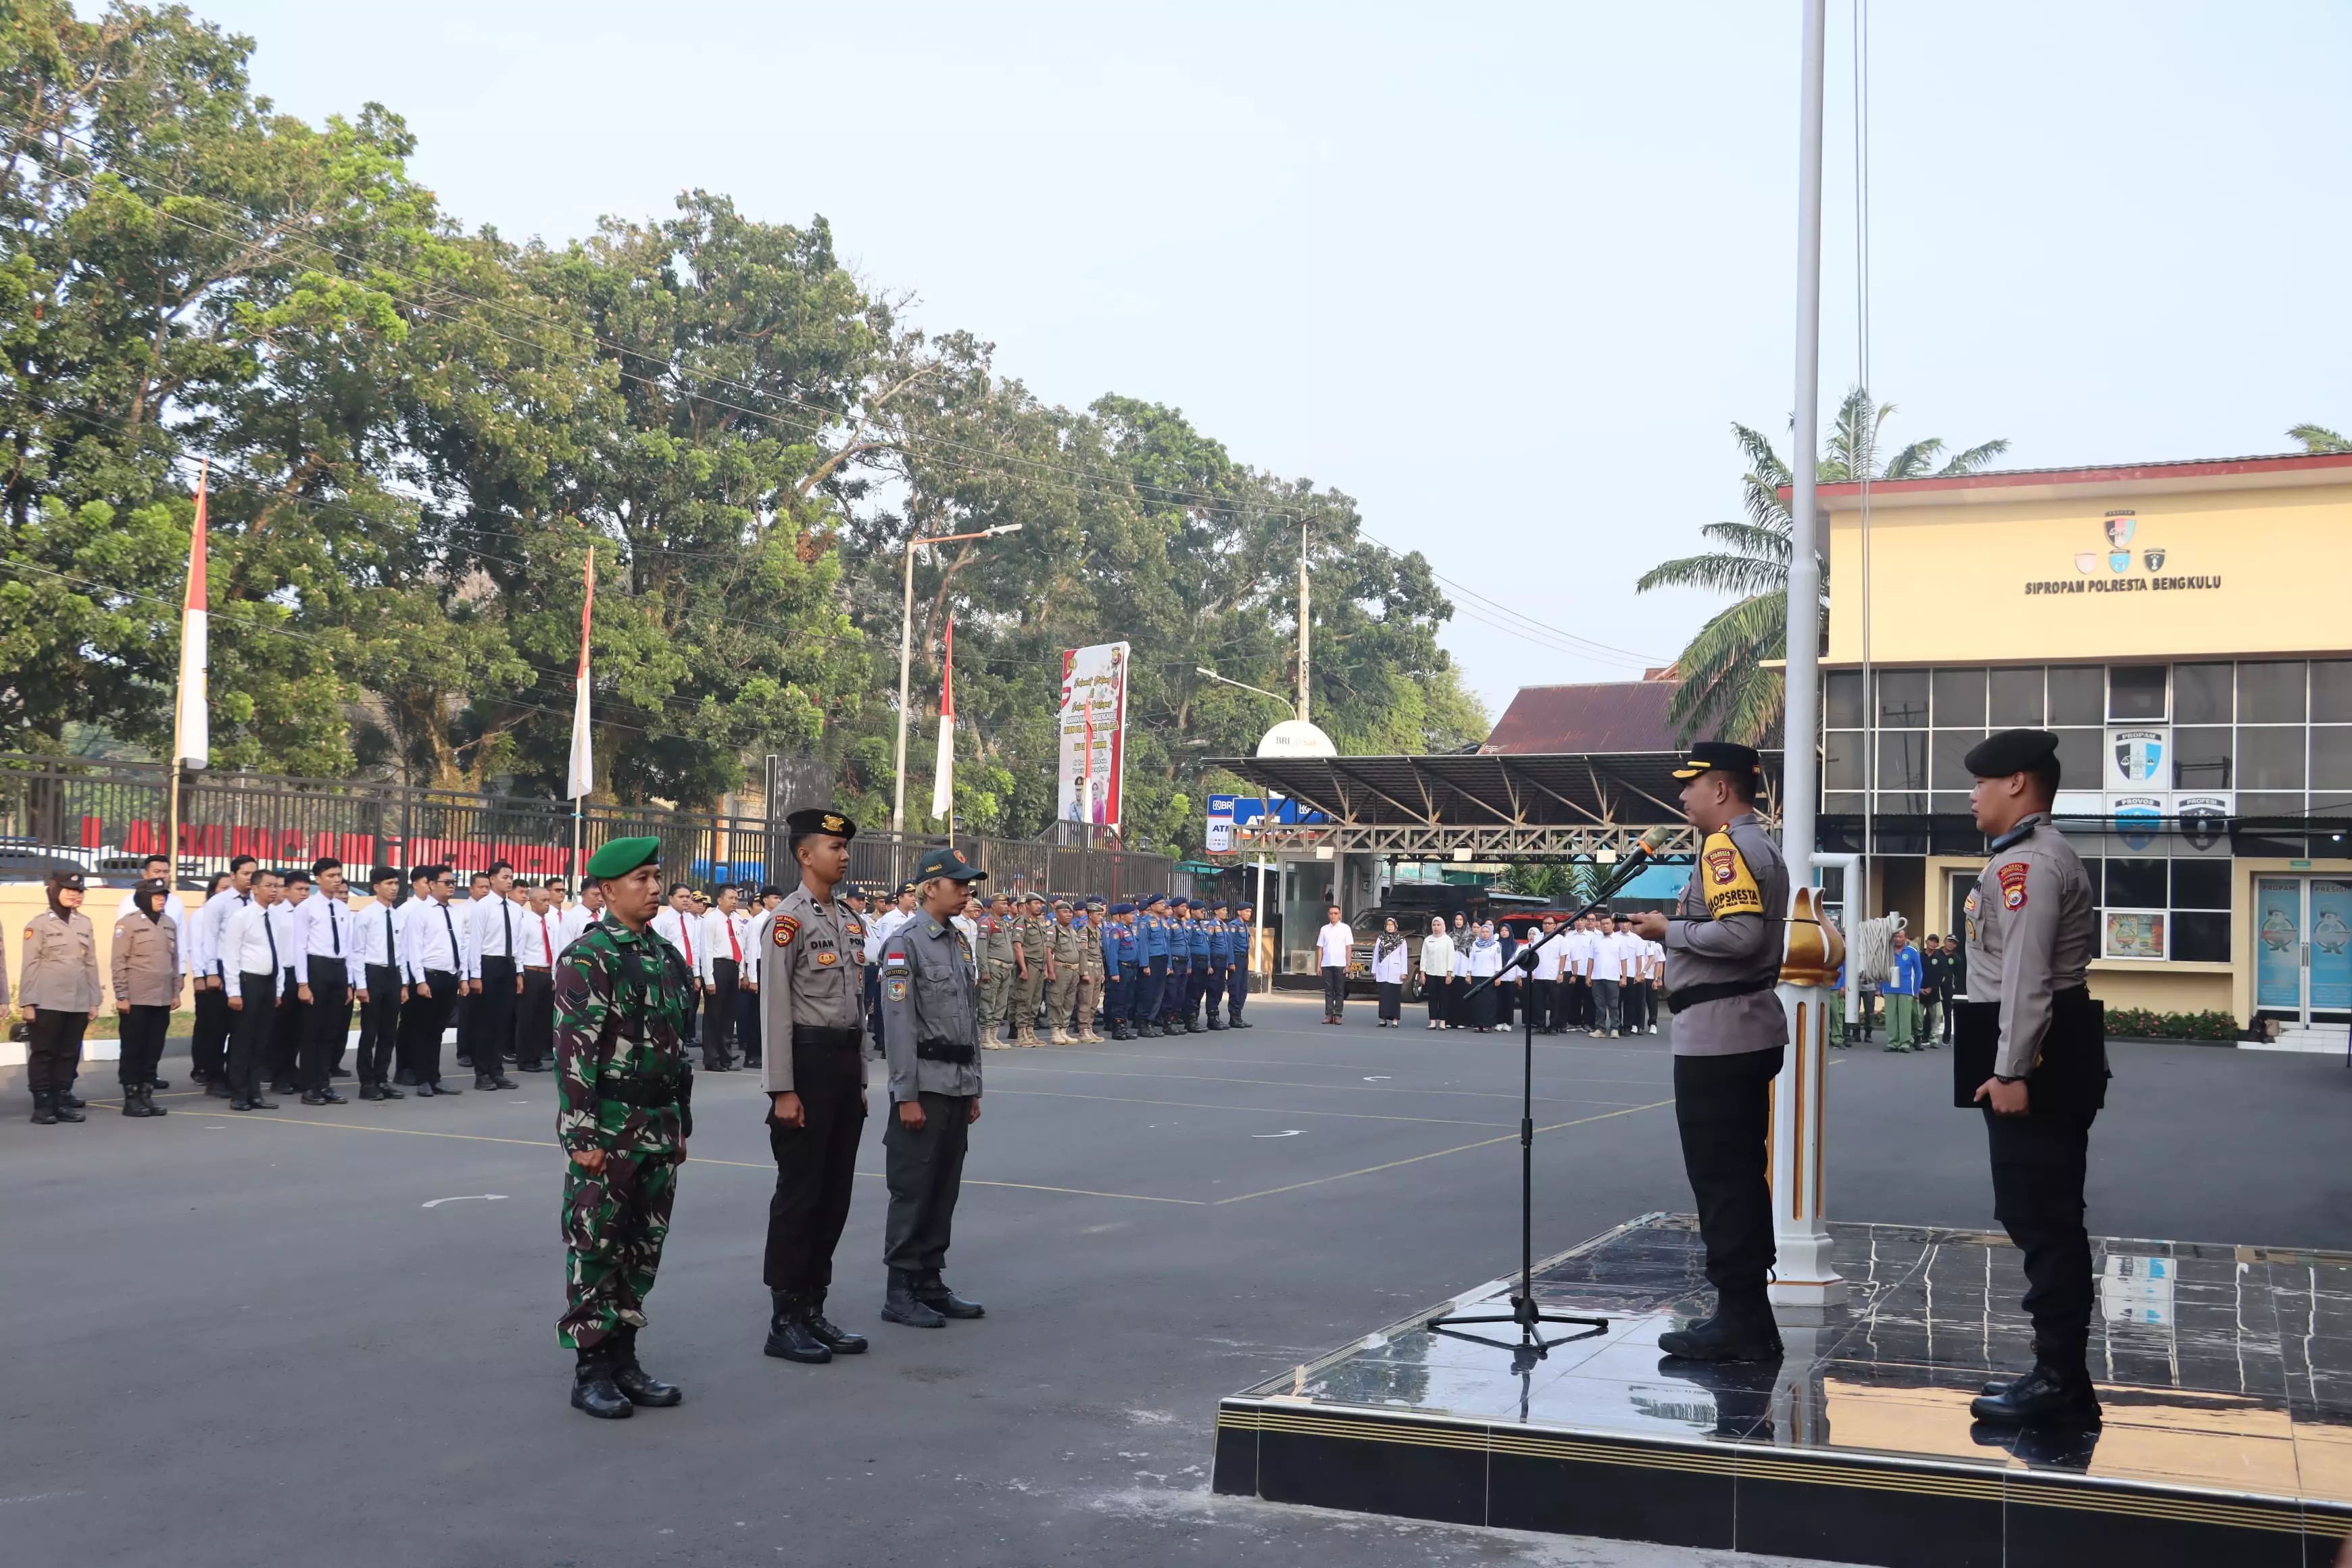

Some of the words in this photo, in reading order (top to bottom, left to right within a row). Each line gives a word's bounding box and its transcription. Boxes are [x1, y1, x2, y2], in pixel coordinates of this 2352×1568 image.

[2025, 580, 2085, 595] SIPROPAM
[2088, 578, 2147, 592] POLRESTA
[2152, 575, 2222, 590] BENGKULU
[2122, 732, 2156, 740] PROPAM
[1221, 802, 1233, 810] BR
[810, 939, 834, 950] DIAN
